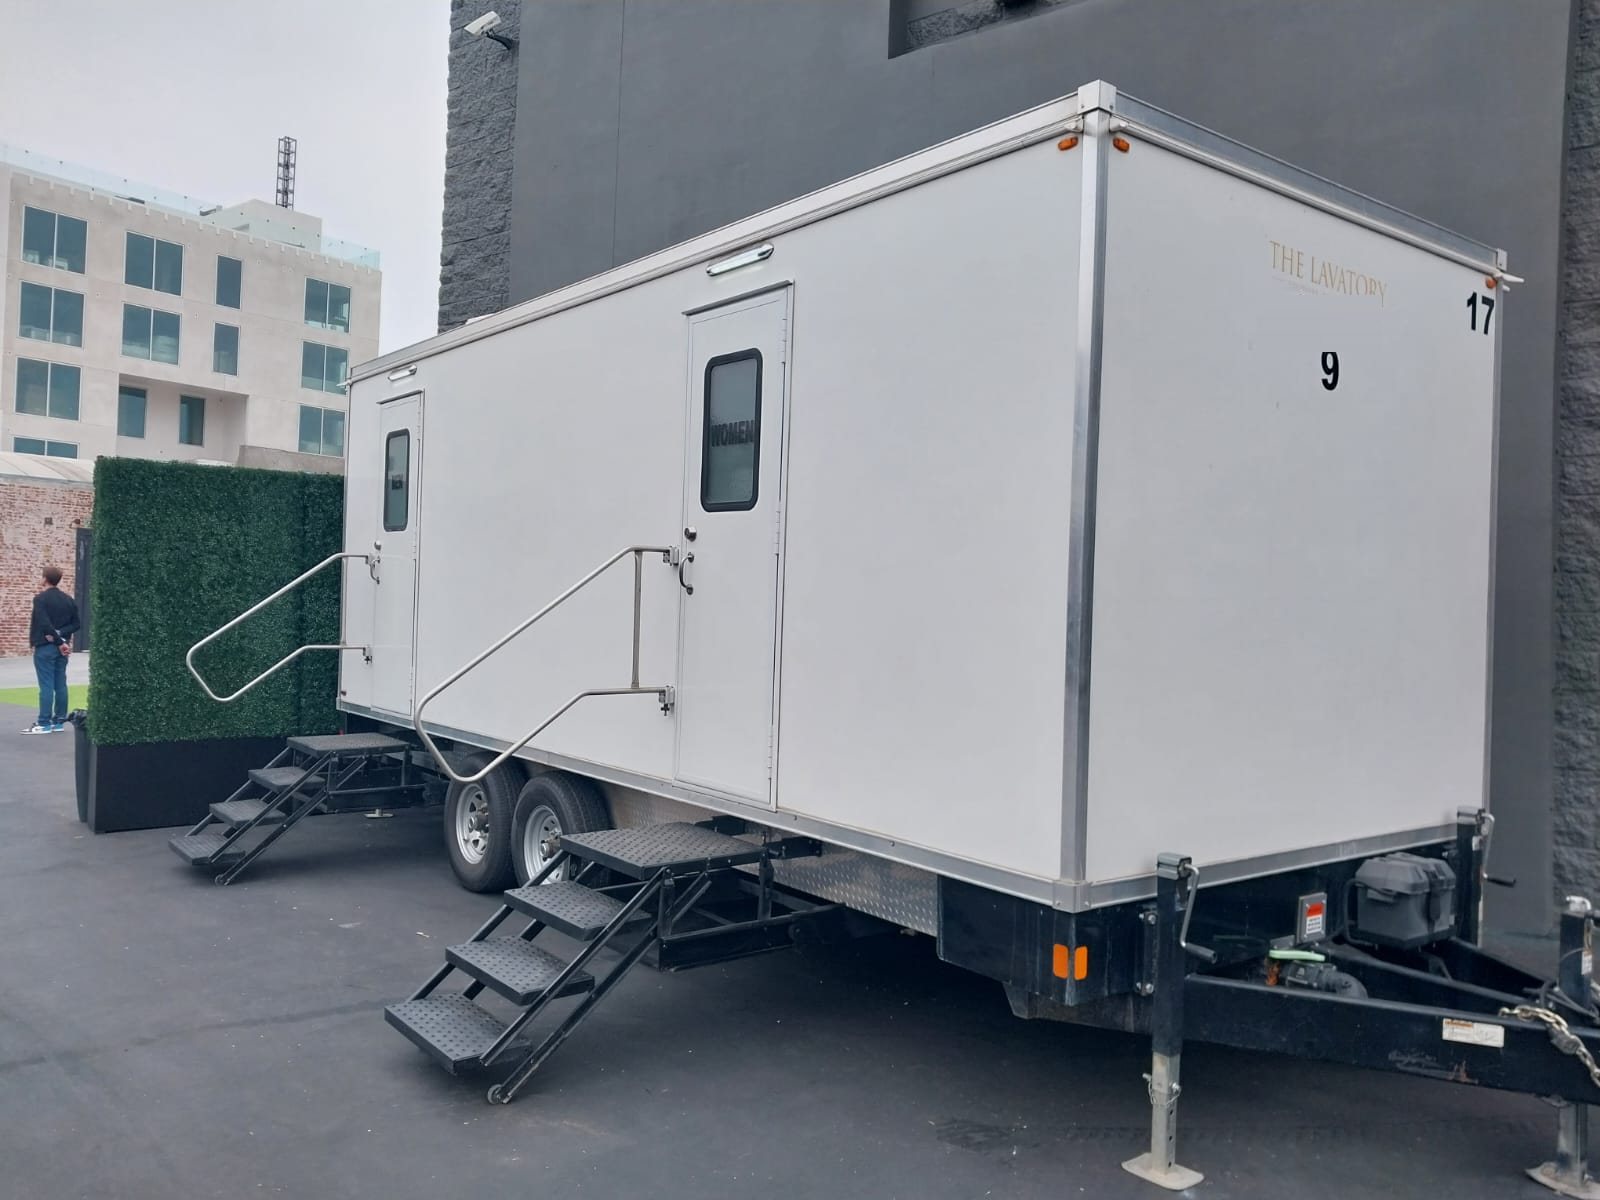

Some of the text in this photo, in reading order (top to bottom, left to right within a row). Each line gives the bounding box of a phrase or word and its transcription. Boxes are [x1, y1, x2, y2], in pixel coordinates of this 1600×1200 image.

[1269, 240, 1304, 279] THE
[1311, 256, 1387, 308] LAVATORY
[1467, 291, 1494, 335] 17
[1321, 352, 1339, 391] 9
[711, 419, 754, 447] WOMEN
